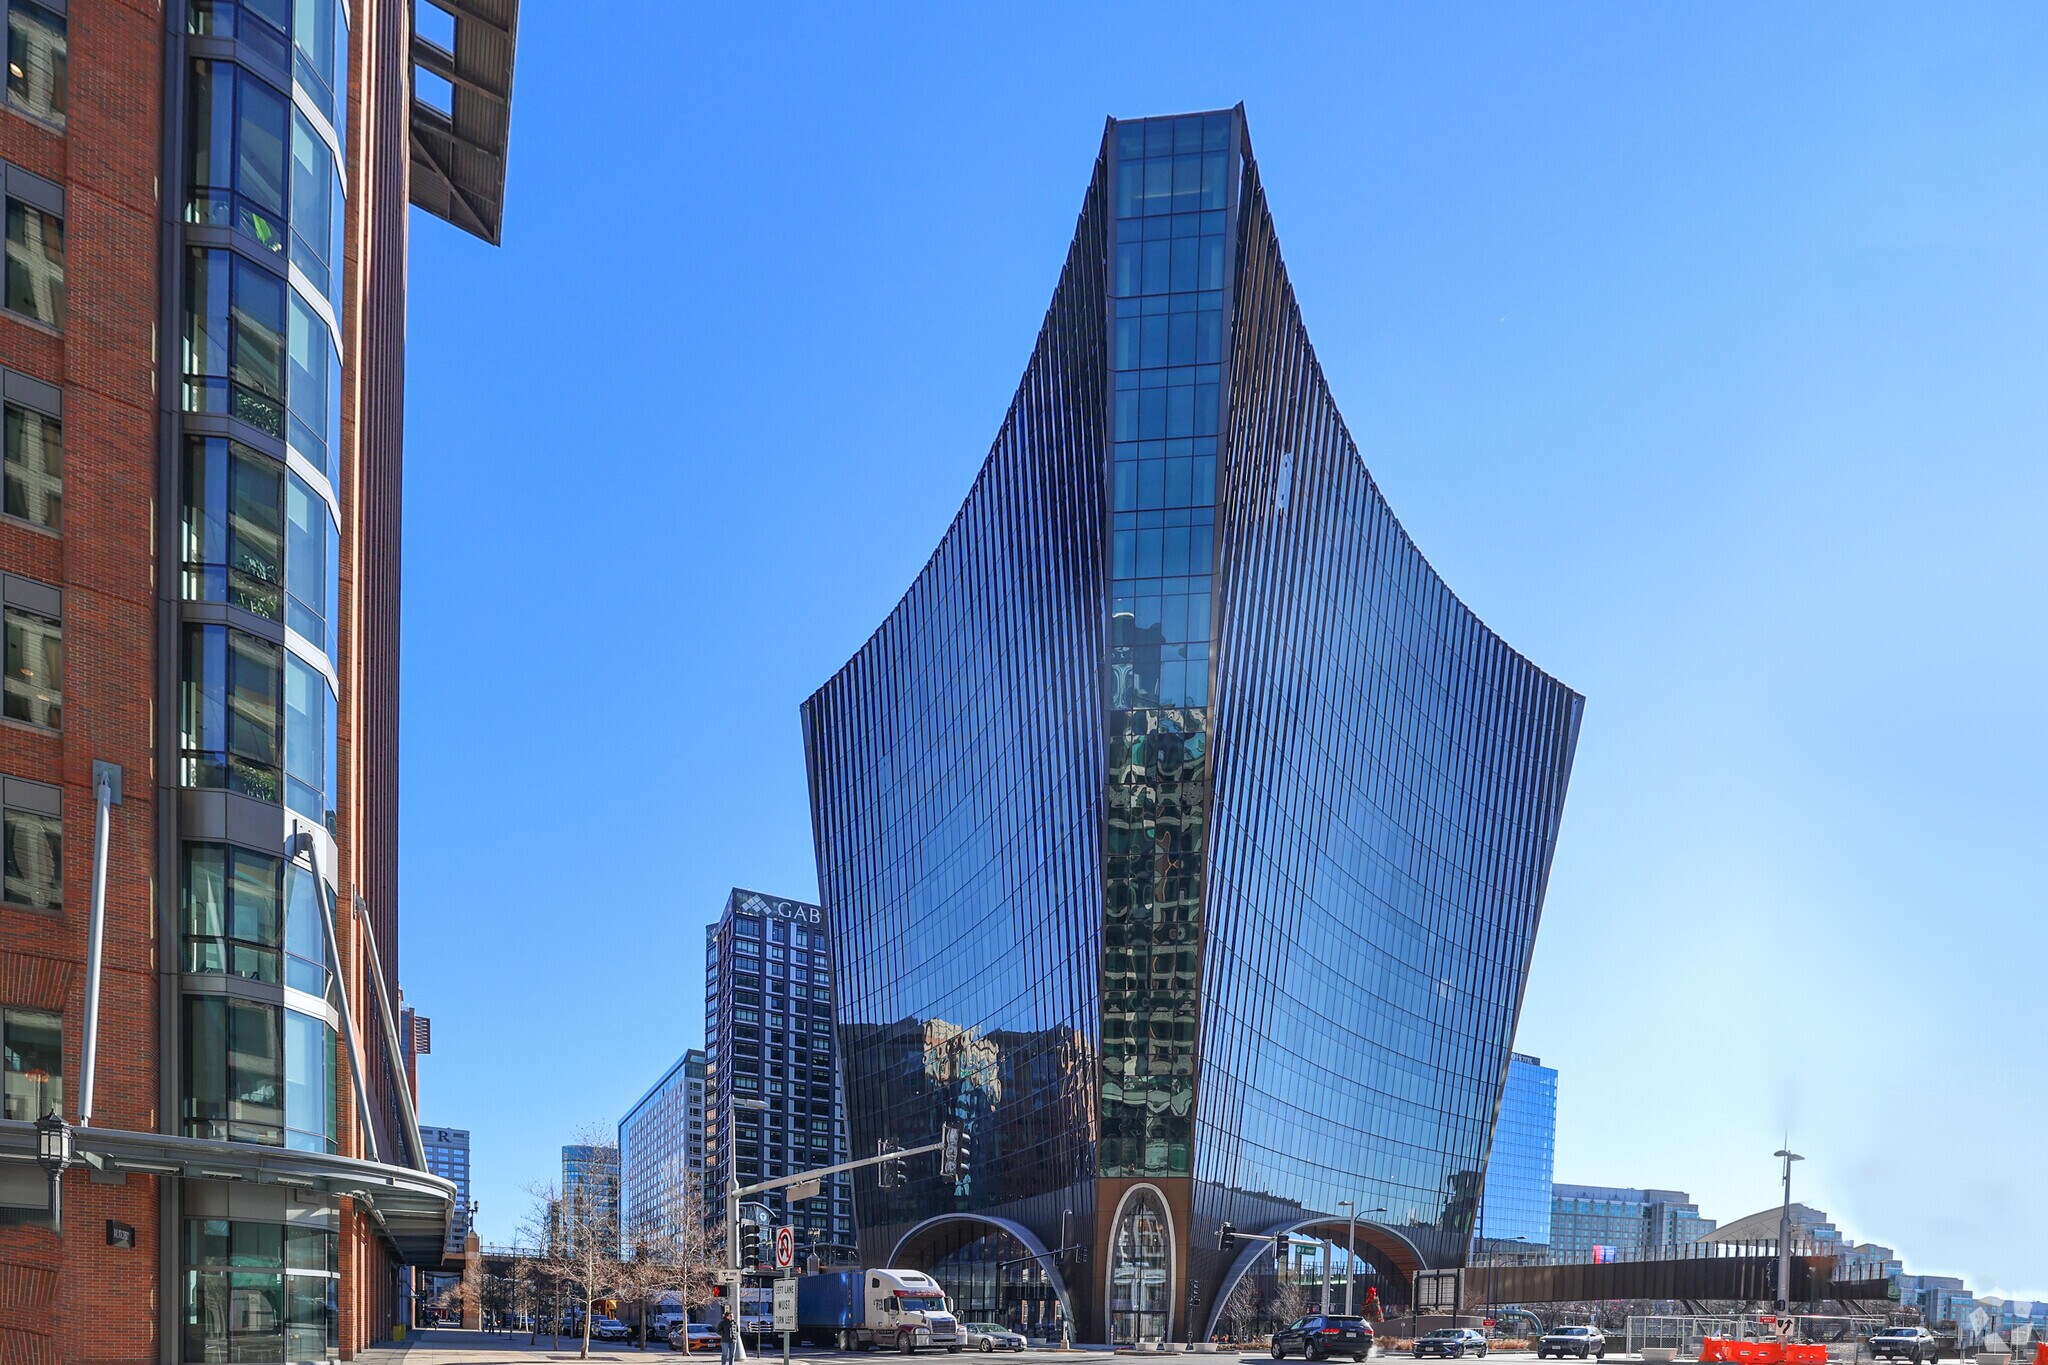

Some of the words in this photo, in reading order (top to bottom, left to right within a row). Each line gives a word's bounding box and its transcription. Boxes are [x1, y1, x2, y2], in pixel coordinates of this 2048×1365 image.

[778, 902, 820, 924] GAB
[438, 1130, 452, 1143] R
[785, 1315, 794, 1325] LEFT
